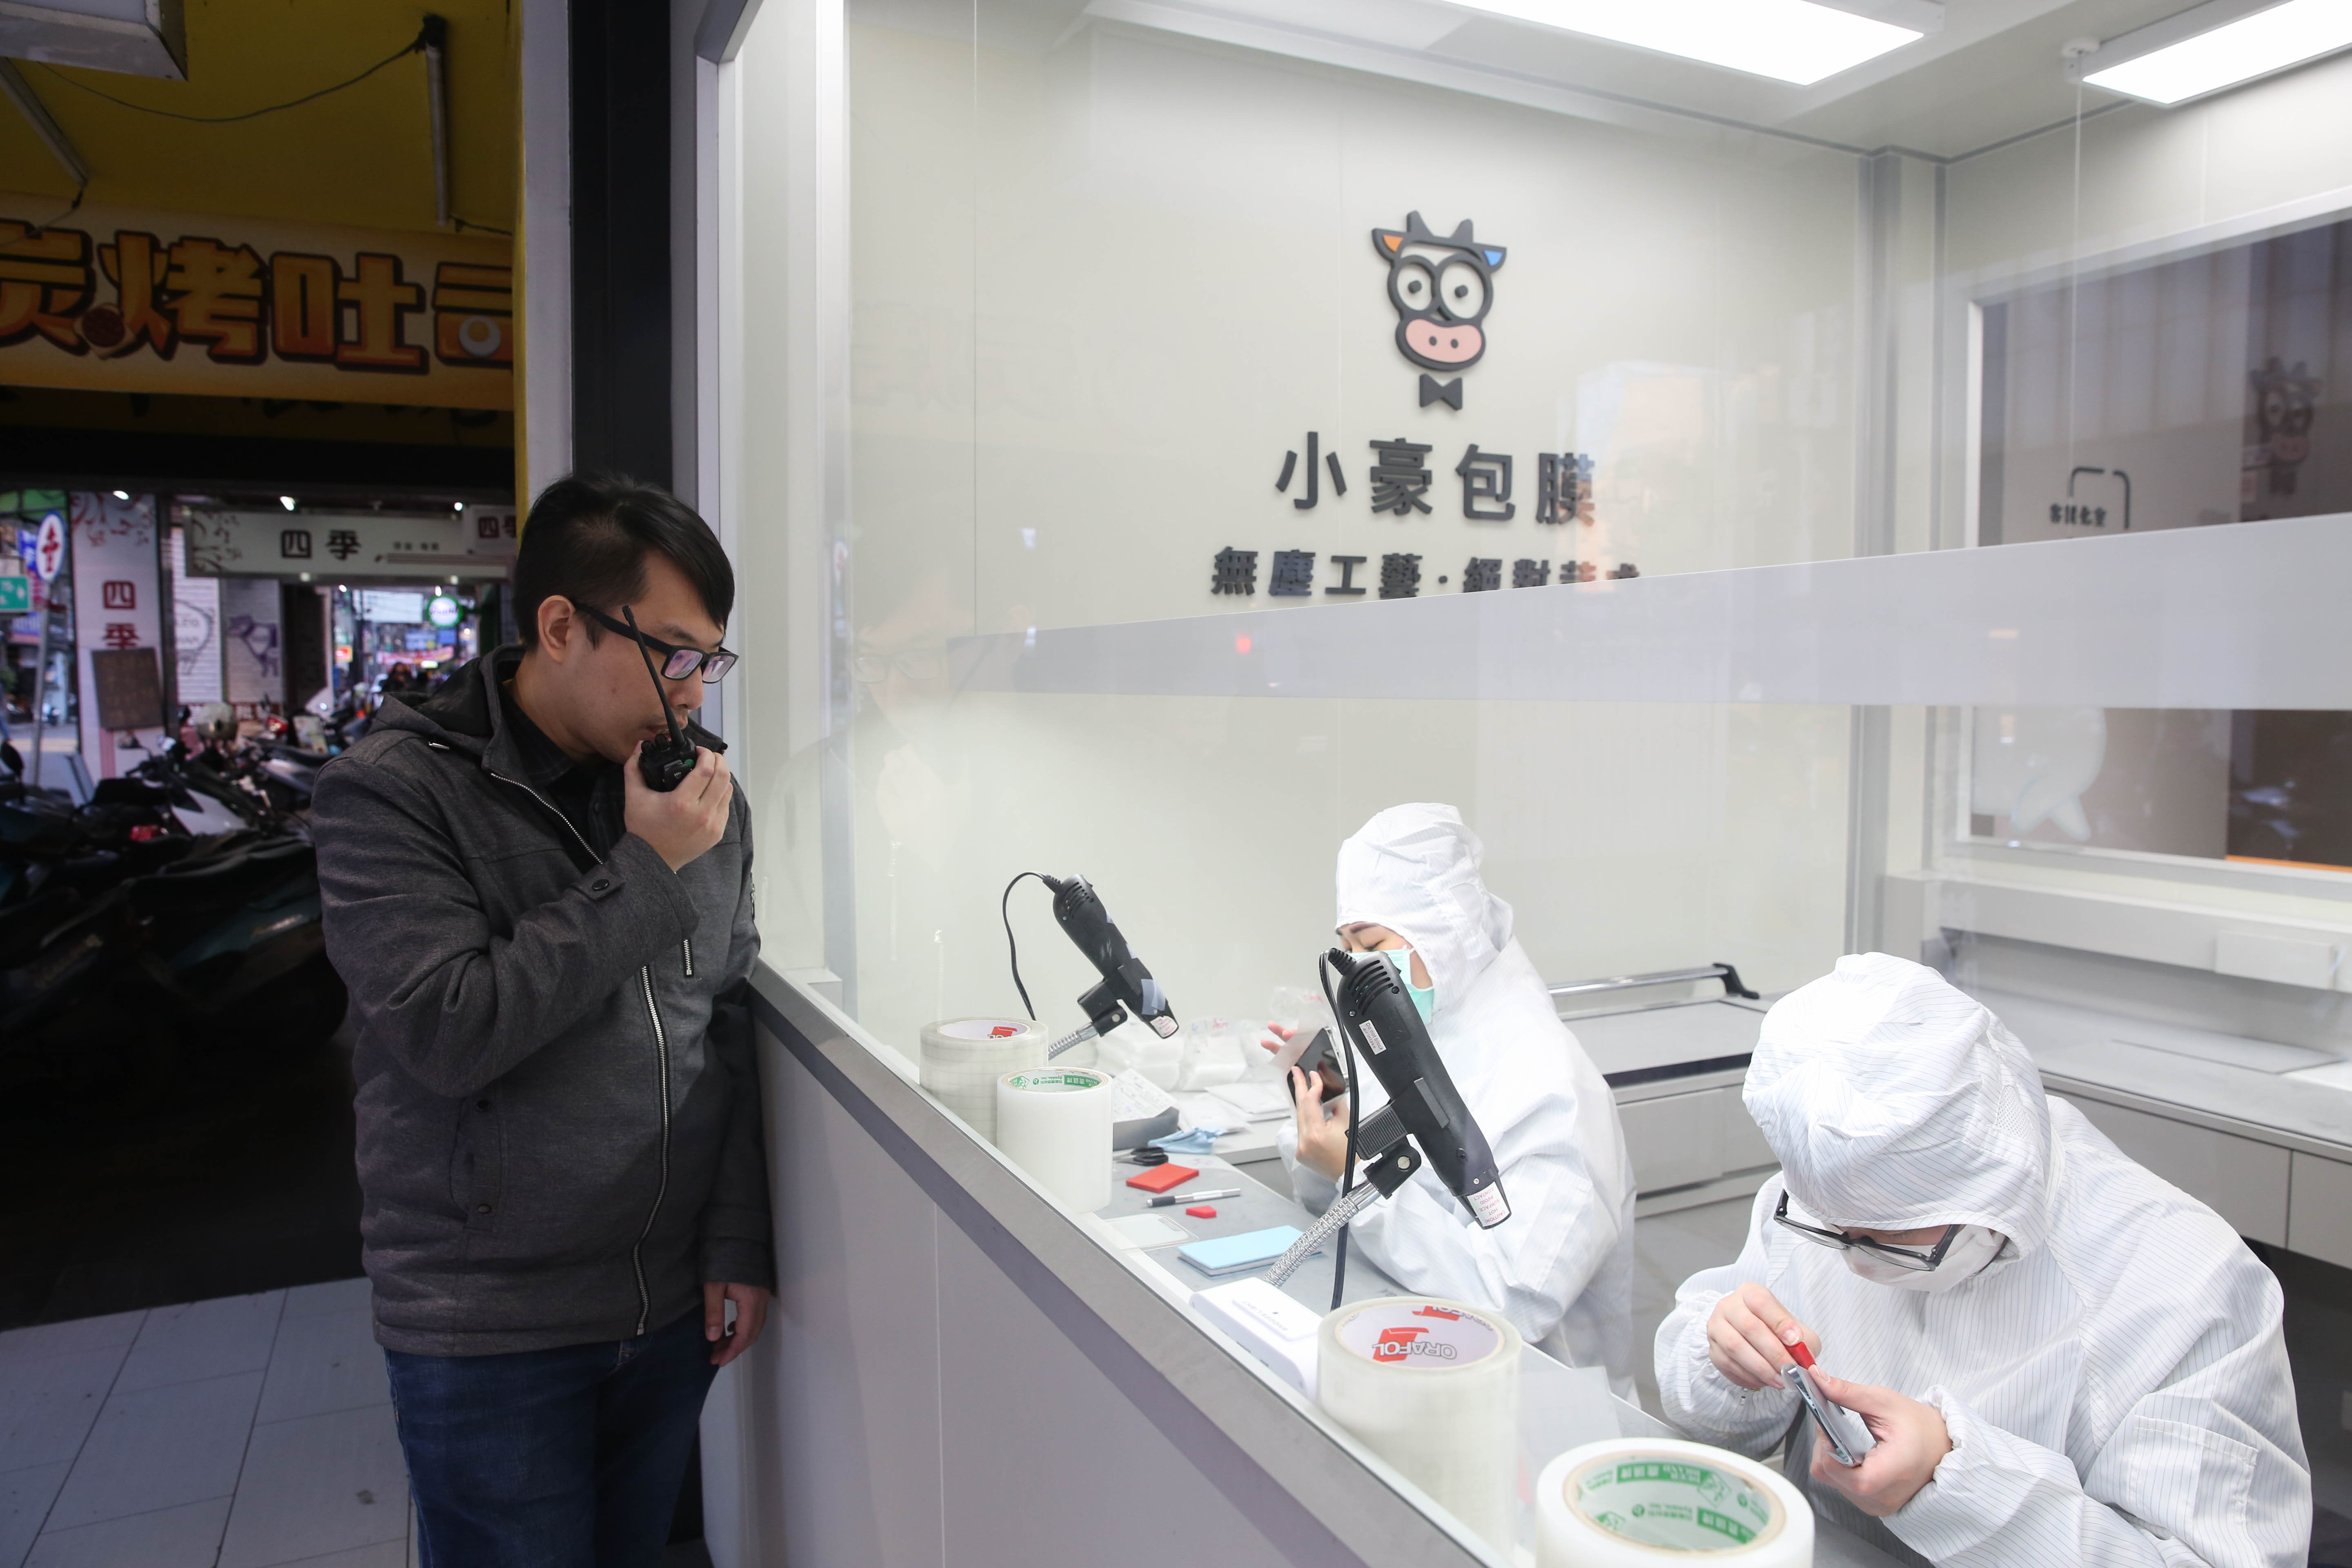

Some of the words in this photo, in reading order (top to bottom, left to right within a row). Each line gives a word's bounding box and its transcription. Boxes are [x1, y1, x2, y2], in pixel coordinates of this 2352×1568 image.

[1276, 431, 1595, 526] 小豪包膜
[281, 529, 361, 561] 四季
[103, 581, 140, 649] 四季
[1374, 1037, 1383, 1050] block
[1473, 1187, 1494, 1201] CONTACT
[1479, 1195, 1493, 1205] AVOID
[1479, 1198, 1500, 1212] SURFACE
[1489, 1207, 1498, 1216] HOT
[1372, 1341, 1457, 1360] ORAFOL
